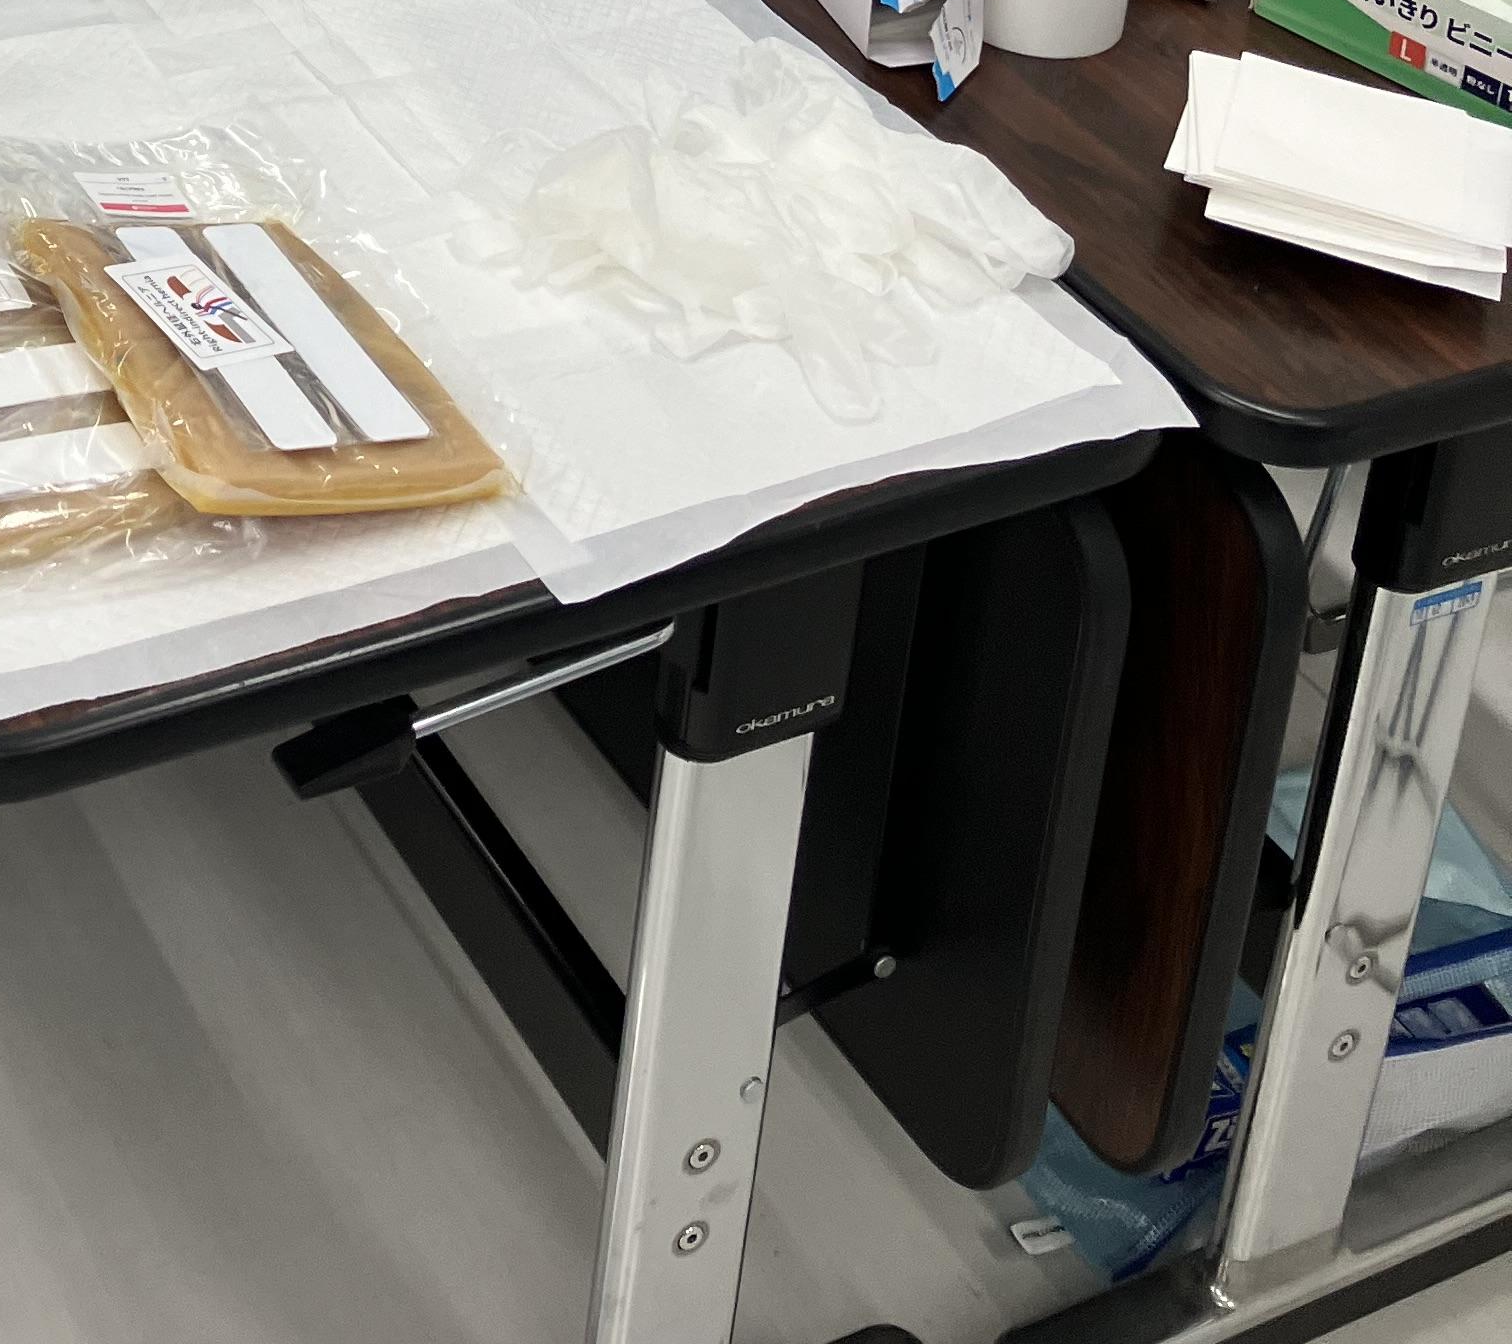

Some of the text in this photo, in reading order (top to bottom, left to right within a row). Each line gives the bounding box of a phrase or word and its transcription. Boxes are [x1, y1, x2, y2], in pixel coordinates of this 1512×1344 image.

[1399, 38, 1413, 63] L
[142, 275, 172, 302] hernia
[735, 694, 835, 735] okamura
